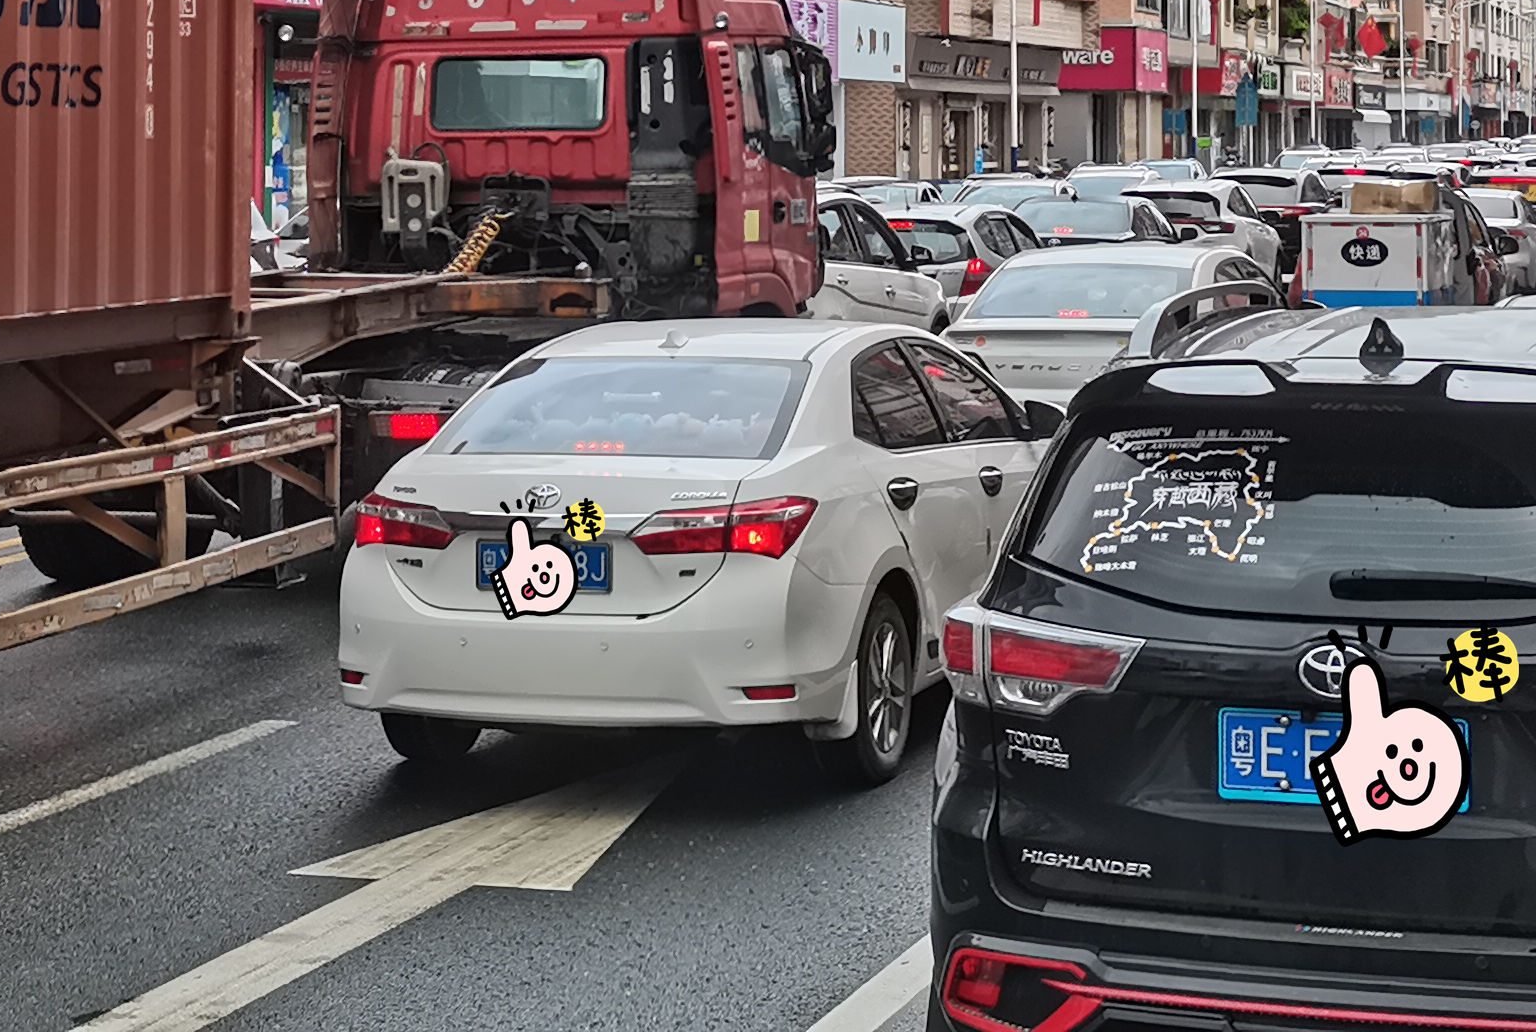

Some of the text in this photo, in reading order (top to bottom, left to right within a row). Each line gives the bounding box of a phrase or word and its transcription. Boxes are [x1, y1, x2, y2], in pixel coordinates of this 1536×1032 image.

[179, 21, 192, 37] 33
[1349, 244, 1381, 261] 快递
[1138, 481, 1240, 518] 穿越西藏
[1005, 728, 1063, 752] TOYOTA
[1021, 849, 1153, 879] HIGHLANDER
